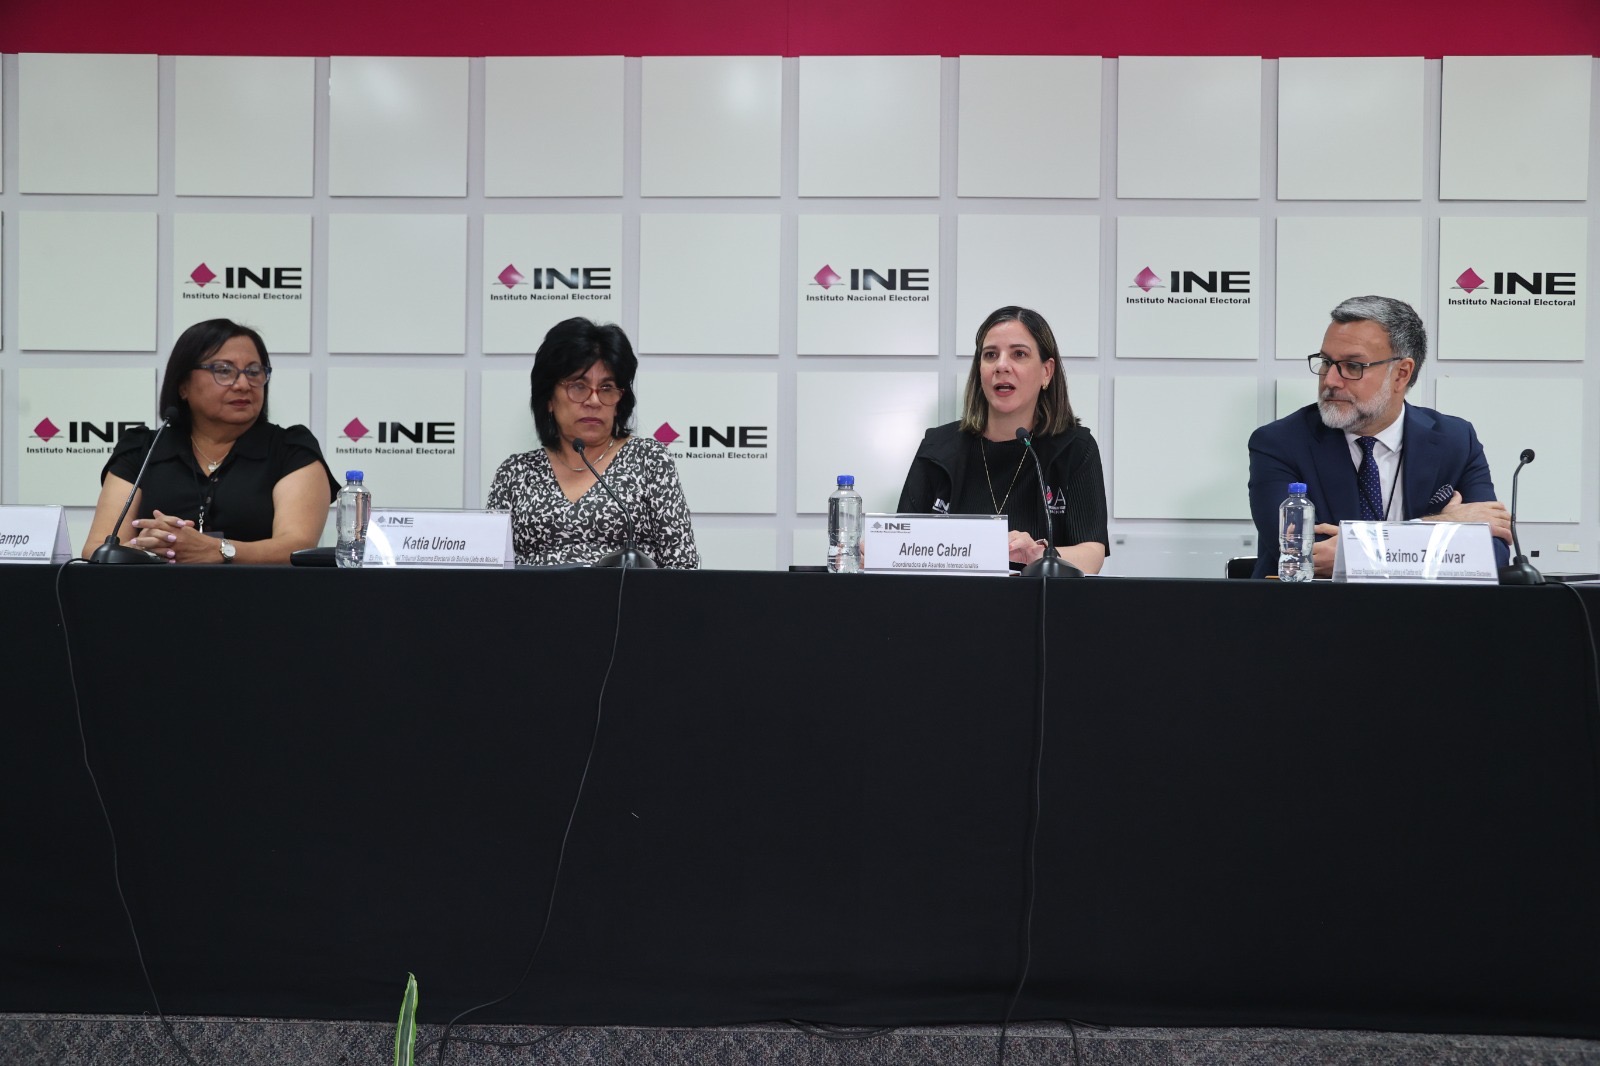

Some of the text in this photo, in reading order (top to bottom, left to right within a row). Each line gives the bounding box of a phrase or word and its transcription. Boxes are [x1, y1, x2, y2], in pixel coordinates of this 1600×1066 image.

[225, 267, 302, 289] INE
[533, 267, 611, 289] INE
[850, 268, 929, 291] INE
[1170, 270, 1250, 293] INE
[1494, 271, 1576, 295] INE
[1126, 296, 1250, 304] Instituto Nacional Electoral
[1490, 298, 1531, 306] Nacional
[378, 421, 455, 443] INE
[689, 426, 767, 448] INE
[416, 447, 455, 455] Electoral
[686, 451, 725, 459] Nacional
[727, 451, 768, 459] Electoral
[388, 516, 414, 525] INE
[884, 522, 911, 531] INE
[0, 533, 30, 548] ampo
[402, 535, 466, 551] Katia Uriona
[898, 542, 972, 557] Arlene Cabral
